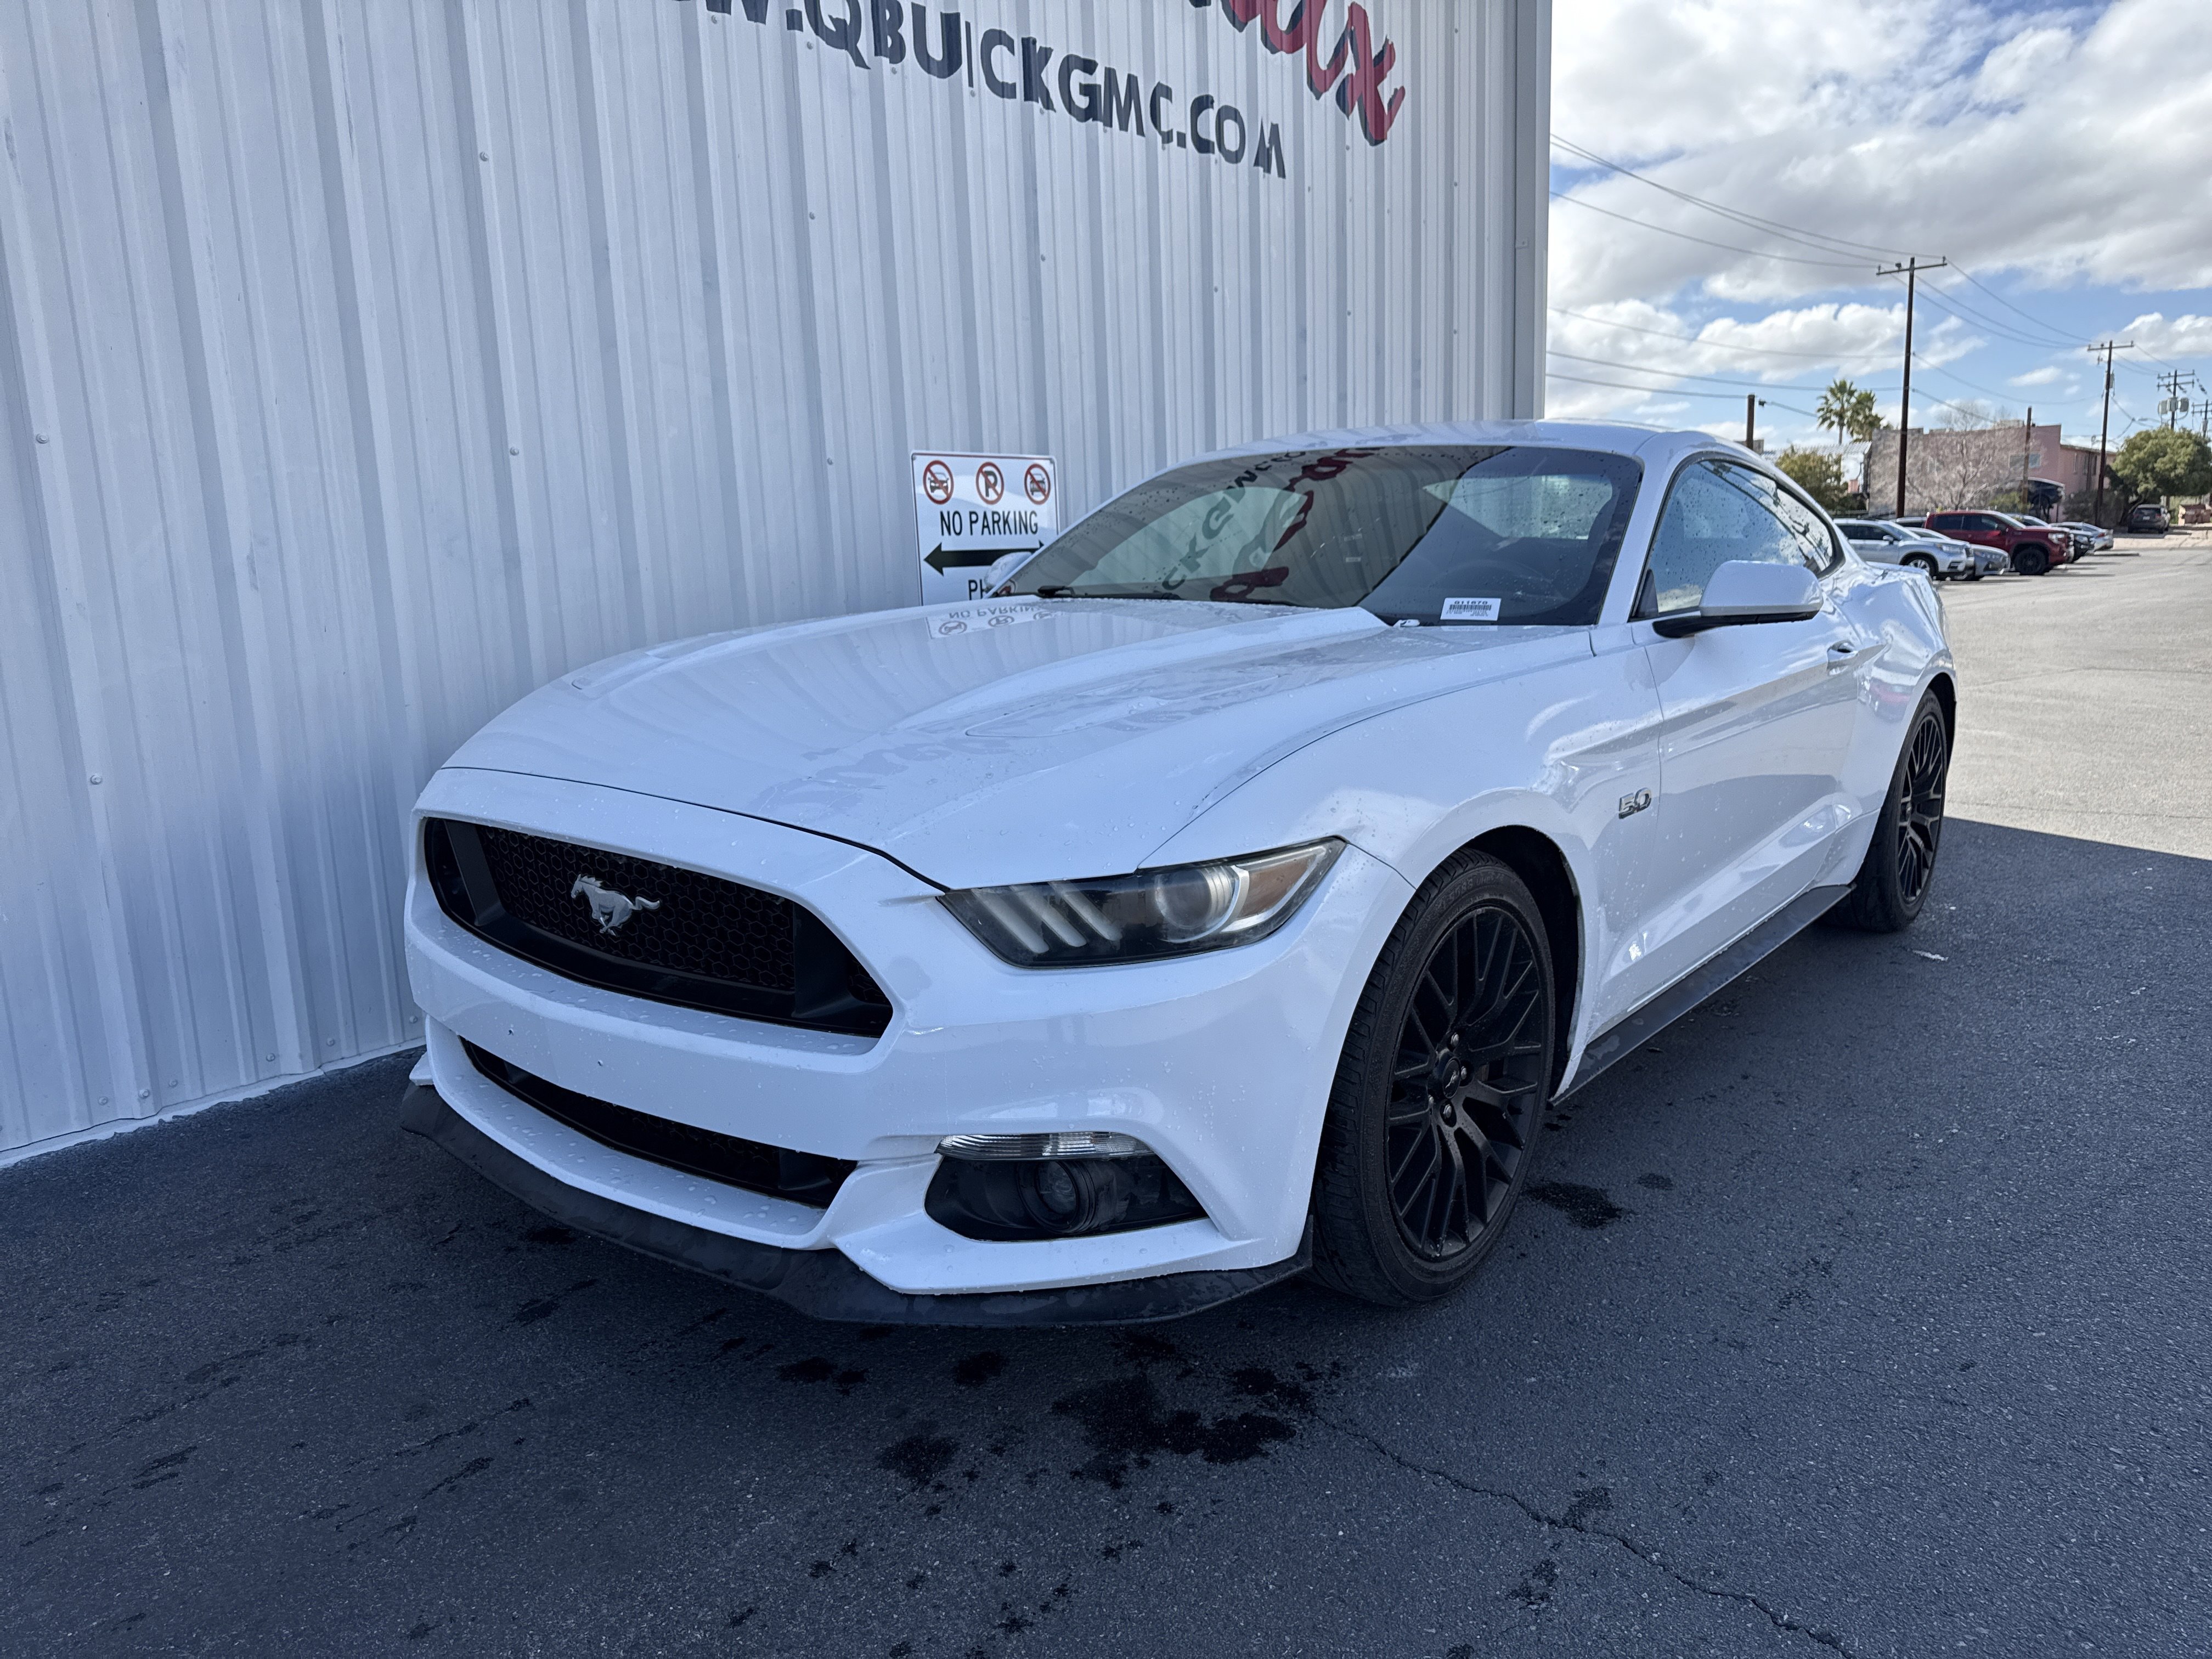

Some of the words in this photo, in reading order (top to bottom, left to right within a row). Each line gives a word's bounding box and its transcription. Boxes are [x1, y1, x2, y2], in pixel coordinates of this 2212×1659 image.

[706, 0, 1285, 179] .QBUICKGMC.COM
[940, 510, 962, 536] NO
[969, 510, 1038, 536] PARKING
[1619, 787, 1652, 819] 5.0
